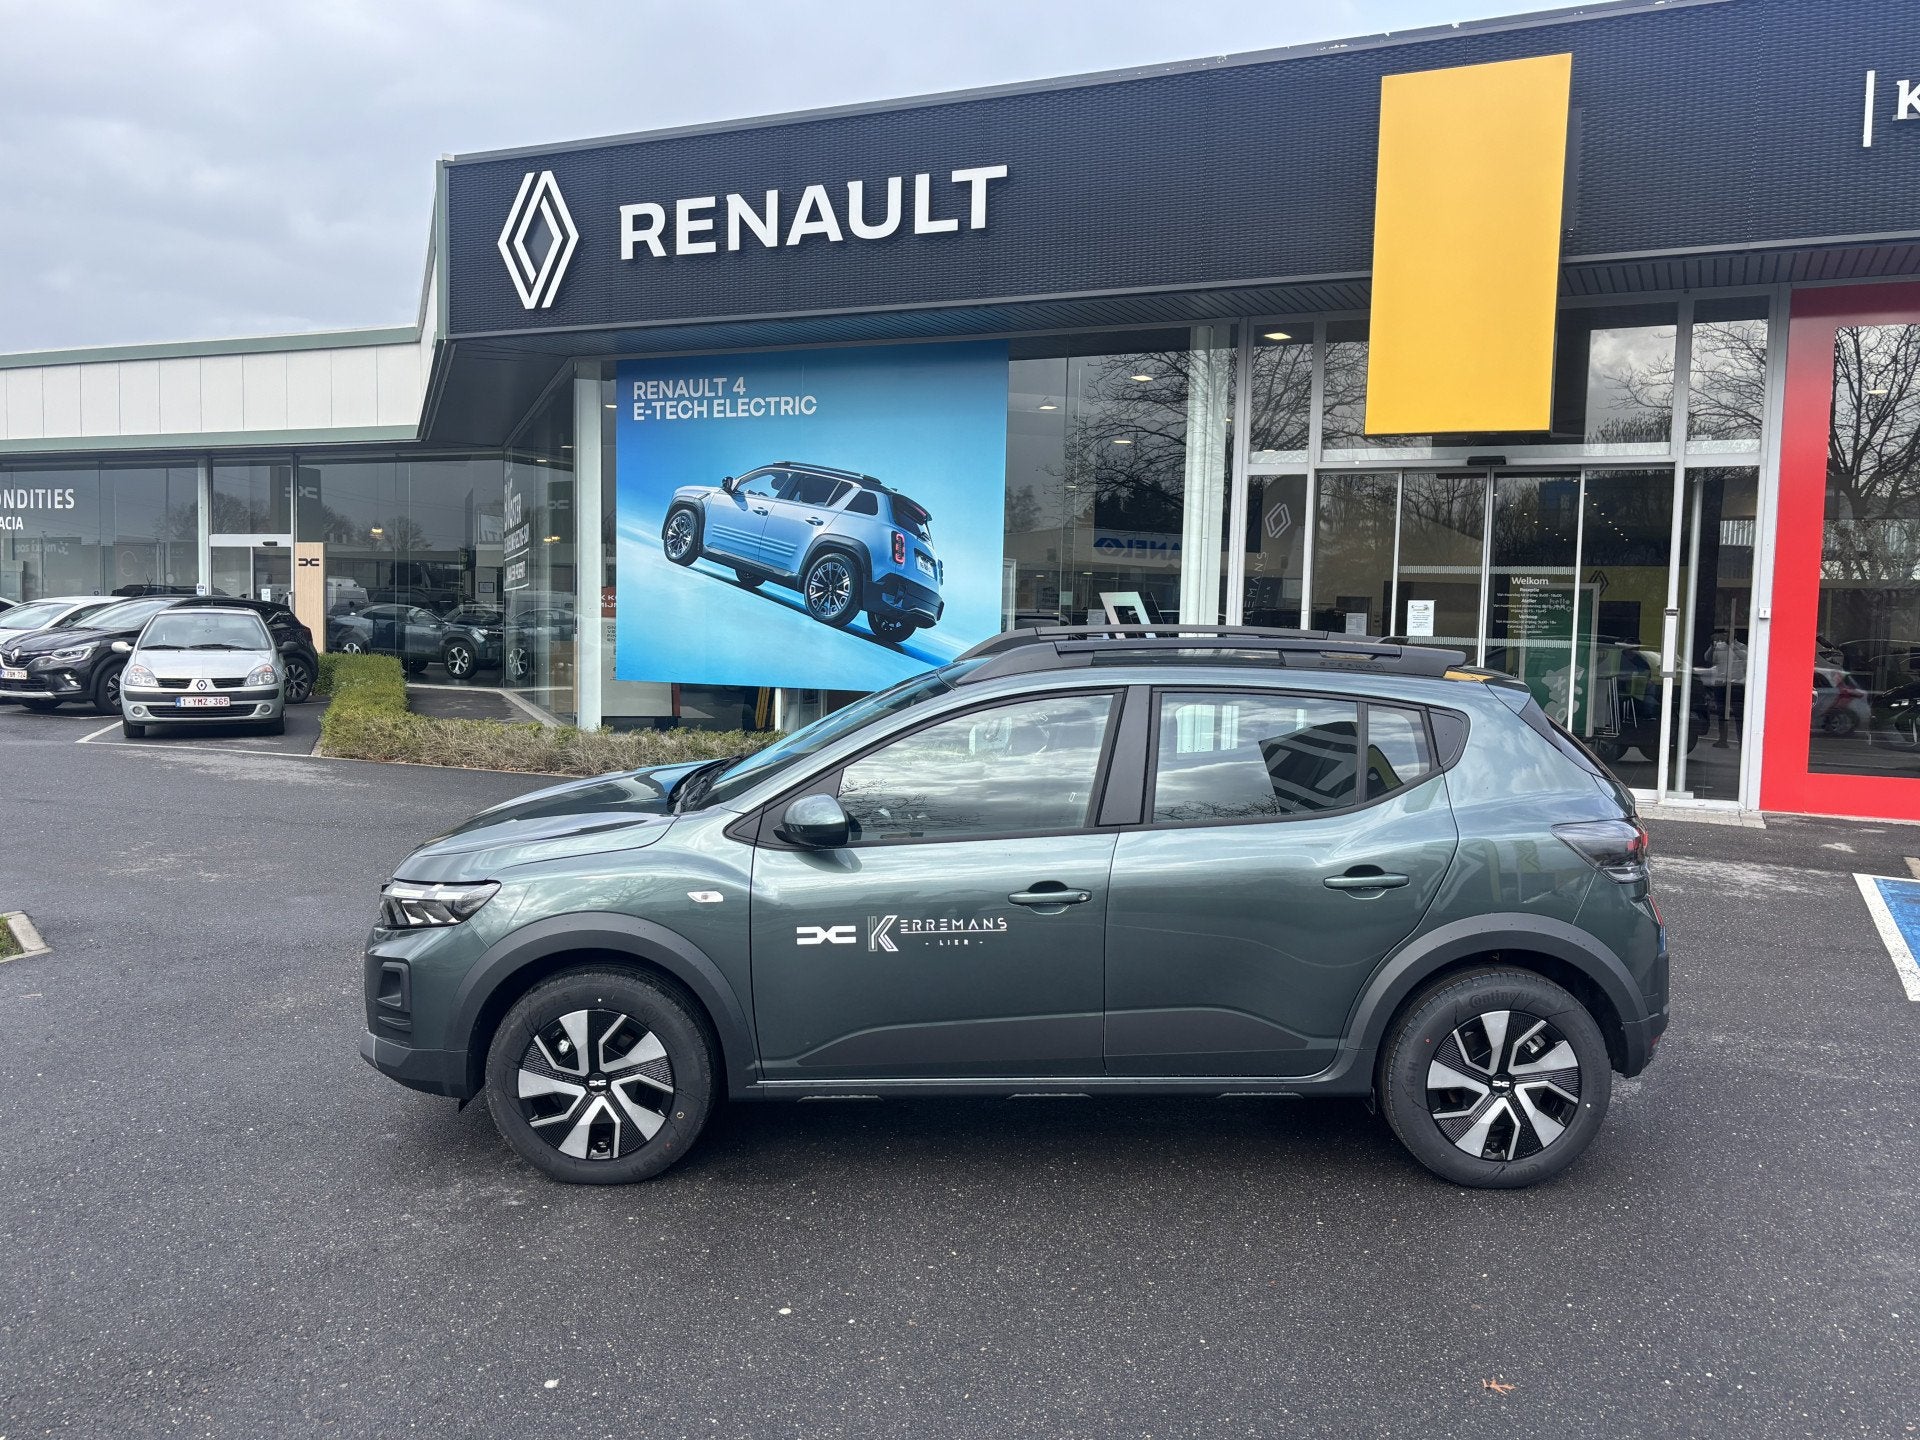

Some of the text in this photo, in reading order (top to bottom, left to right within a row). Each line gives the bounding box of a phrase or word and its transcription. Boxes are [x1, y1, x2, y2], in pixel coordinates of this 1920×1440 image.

[620, 164, 1008, 260] RENAULT
[633, 376, 747, 400] RENAULT 4
[633, 395, 818, 421] E-TECH ELECTRIC
[0, 488, 75, 509] NDITIES
[1511, 576, 1549, 585] Welkom
[181, 697, 230, 707] 1-YMZ-365
